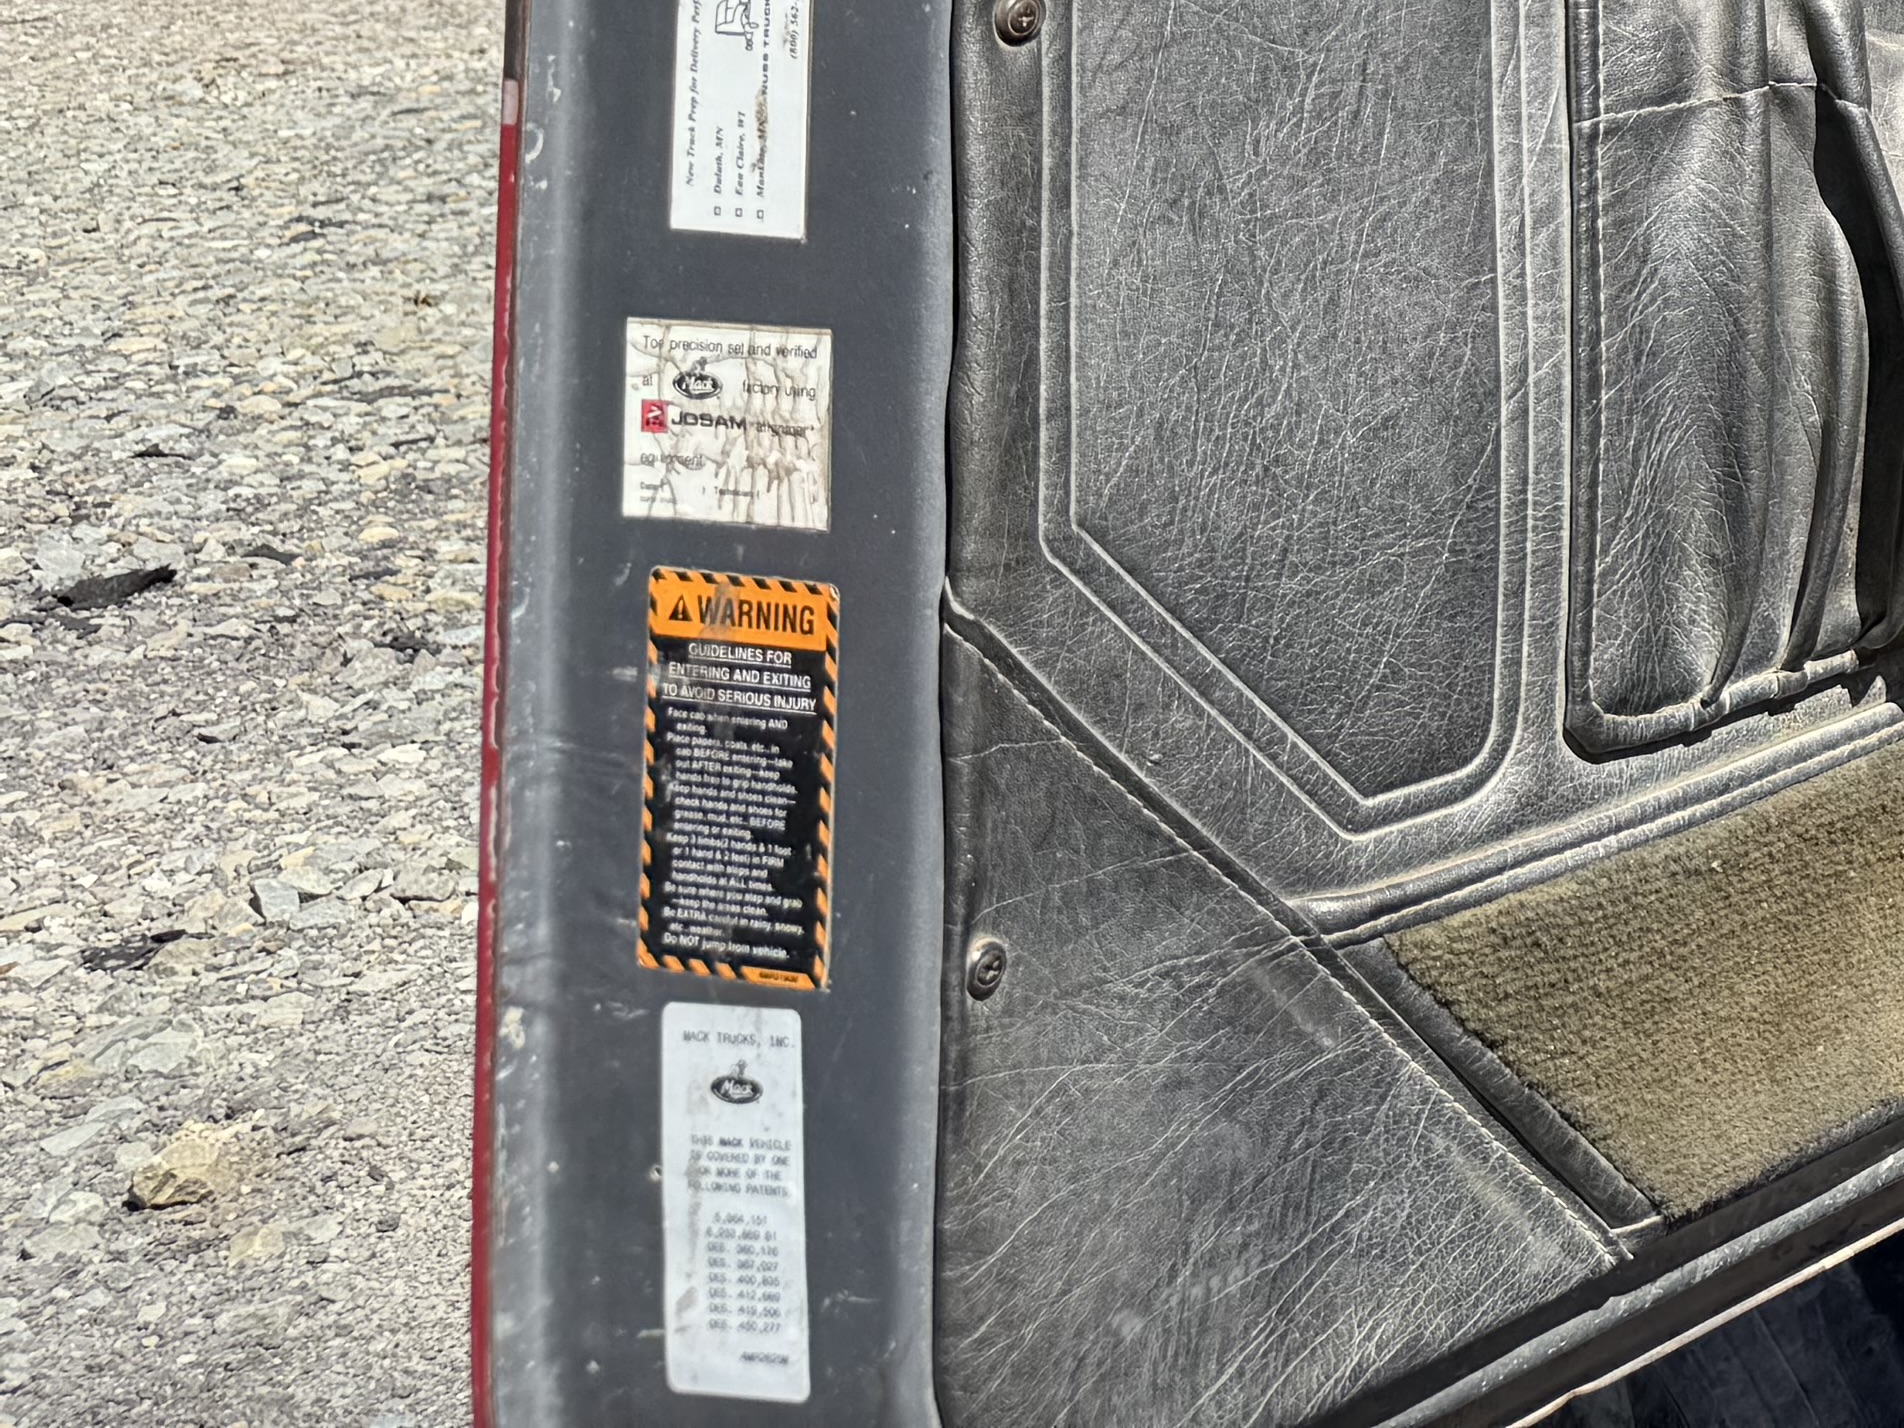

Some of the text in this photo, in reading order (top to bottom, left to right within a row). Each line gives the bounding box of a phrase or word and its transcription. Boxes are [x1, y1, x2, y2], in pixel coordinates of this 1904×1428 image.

[690, 28, 702, 73] Delivery
[689, 77, 700, 94] for
[688, 96, 699, 122] Prep
[686, 126, 696, 157] Truck
[685, 161, 694, 186] New
[669, 338, 722, 354] precision
[728, 343, 744, 355] set
[749, 344, 771, 357] and
[776, 346, 818, 359] verified
[682, 375, 714, 393] Mack
[672, 411, 747, 431] JOSAM
[698, 594, 815, 635] WARNING
[688, 643, 792, 664] GUIDELINES FOR
[669, 662, 811, 688] ENTERING AND EXITING
[663, 683, 816, 711] TO AVOID SERIOUS INJURY
[768, 718, 788, 730] AND
[693, 748, 730, 761] BEFORE
[692, 760, 721, 771] AFTER
[749, 816, 786, 830] BEFORE
[677, 908, 707, 920] EXTRA
[679, 934, 700, 945] NOT
[701, 938, 726, 951] jump
